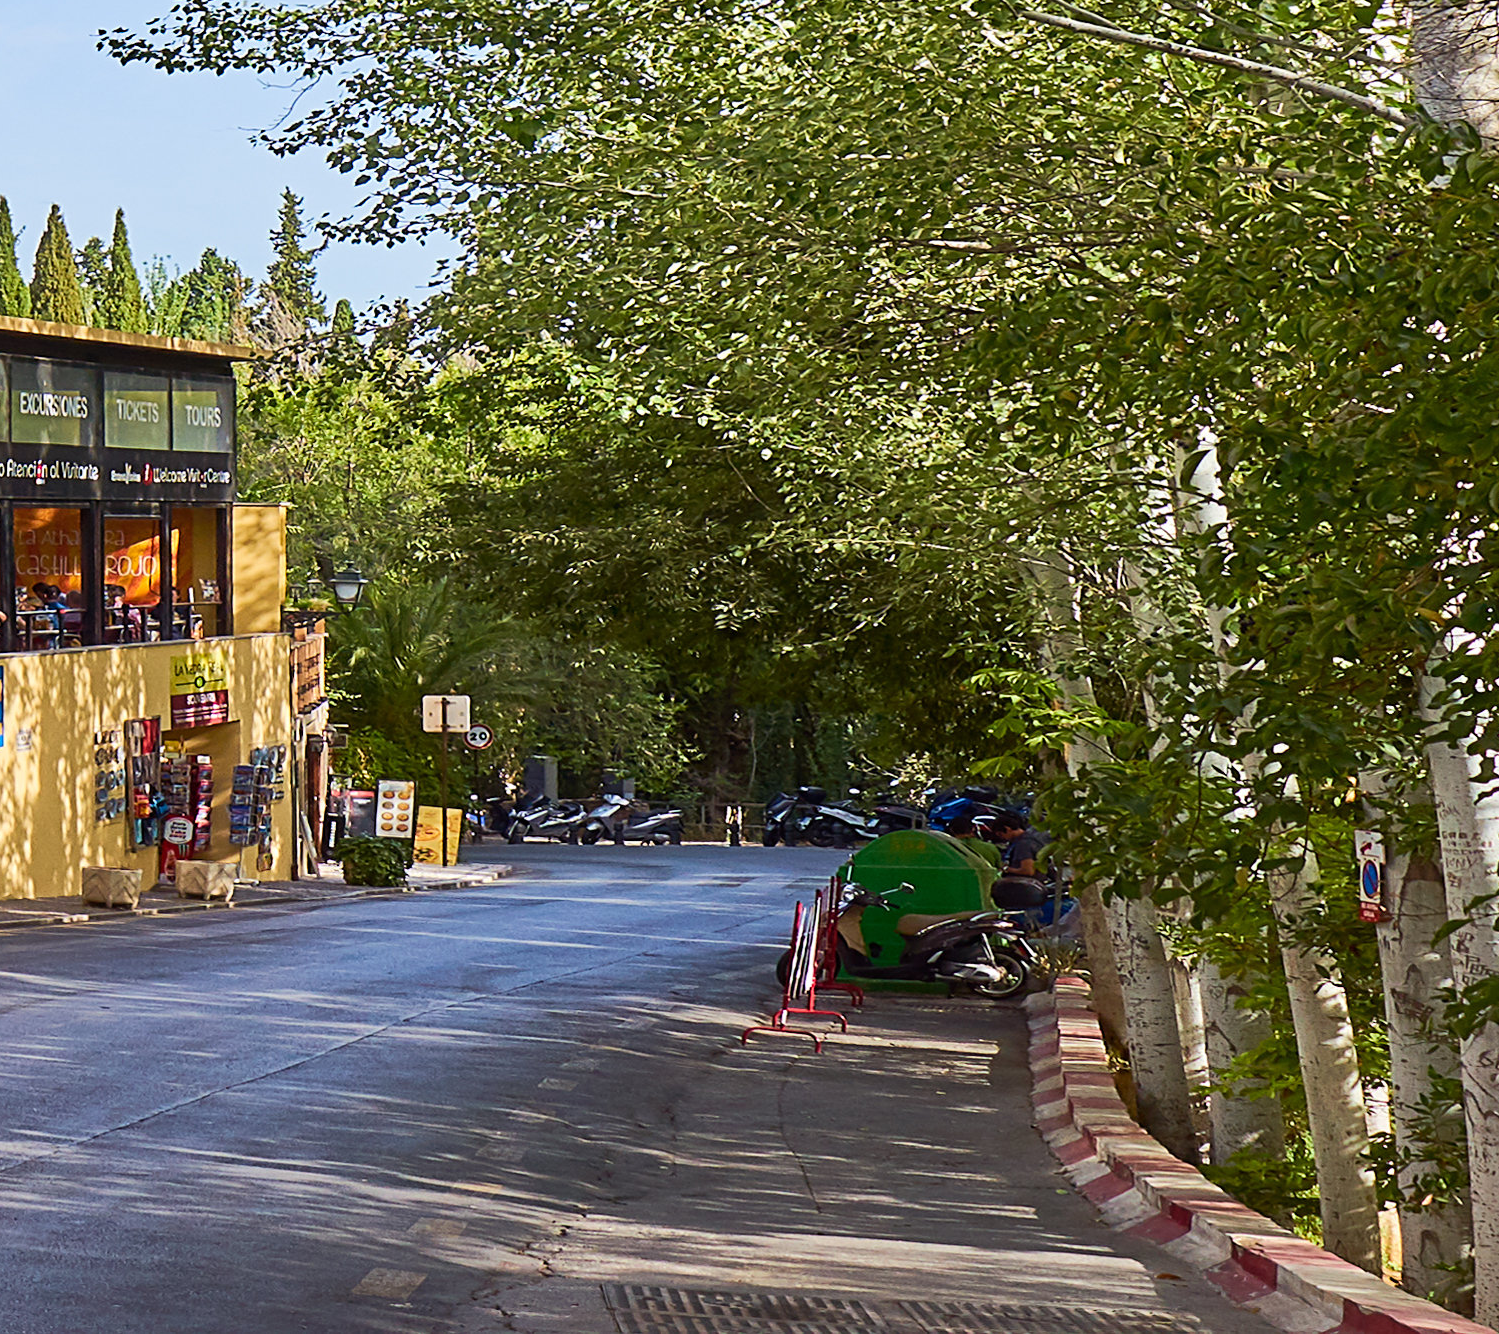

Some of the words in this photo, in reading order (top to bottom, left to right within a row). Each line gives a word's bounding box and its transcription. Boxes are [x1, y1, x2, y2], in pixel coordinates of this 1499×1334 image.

[19, 391, 89, 419] EXCURSIONES
[116, 398, 160, 424] TICKETS
[184, 404, 222, 428] TOURS
[153, 467, 187, 483] Welcome
[207, 467, 231, 484] Centre
[105, 554, 157, 577] ROJO
[469, 732, 488, 742] 20
